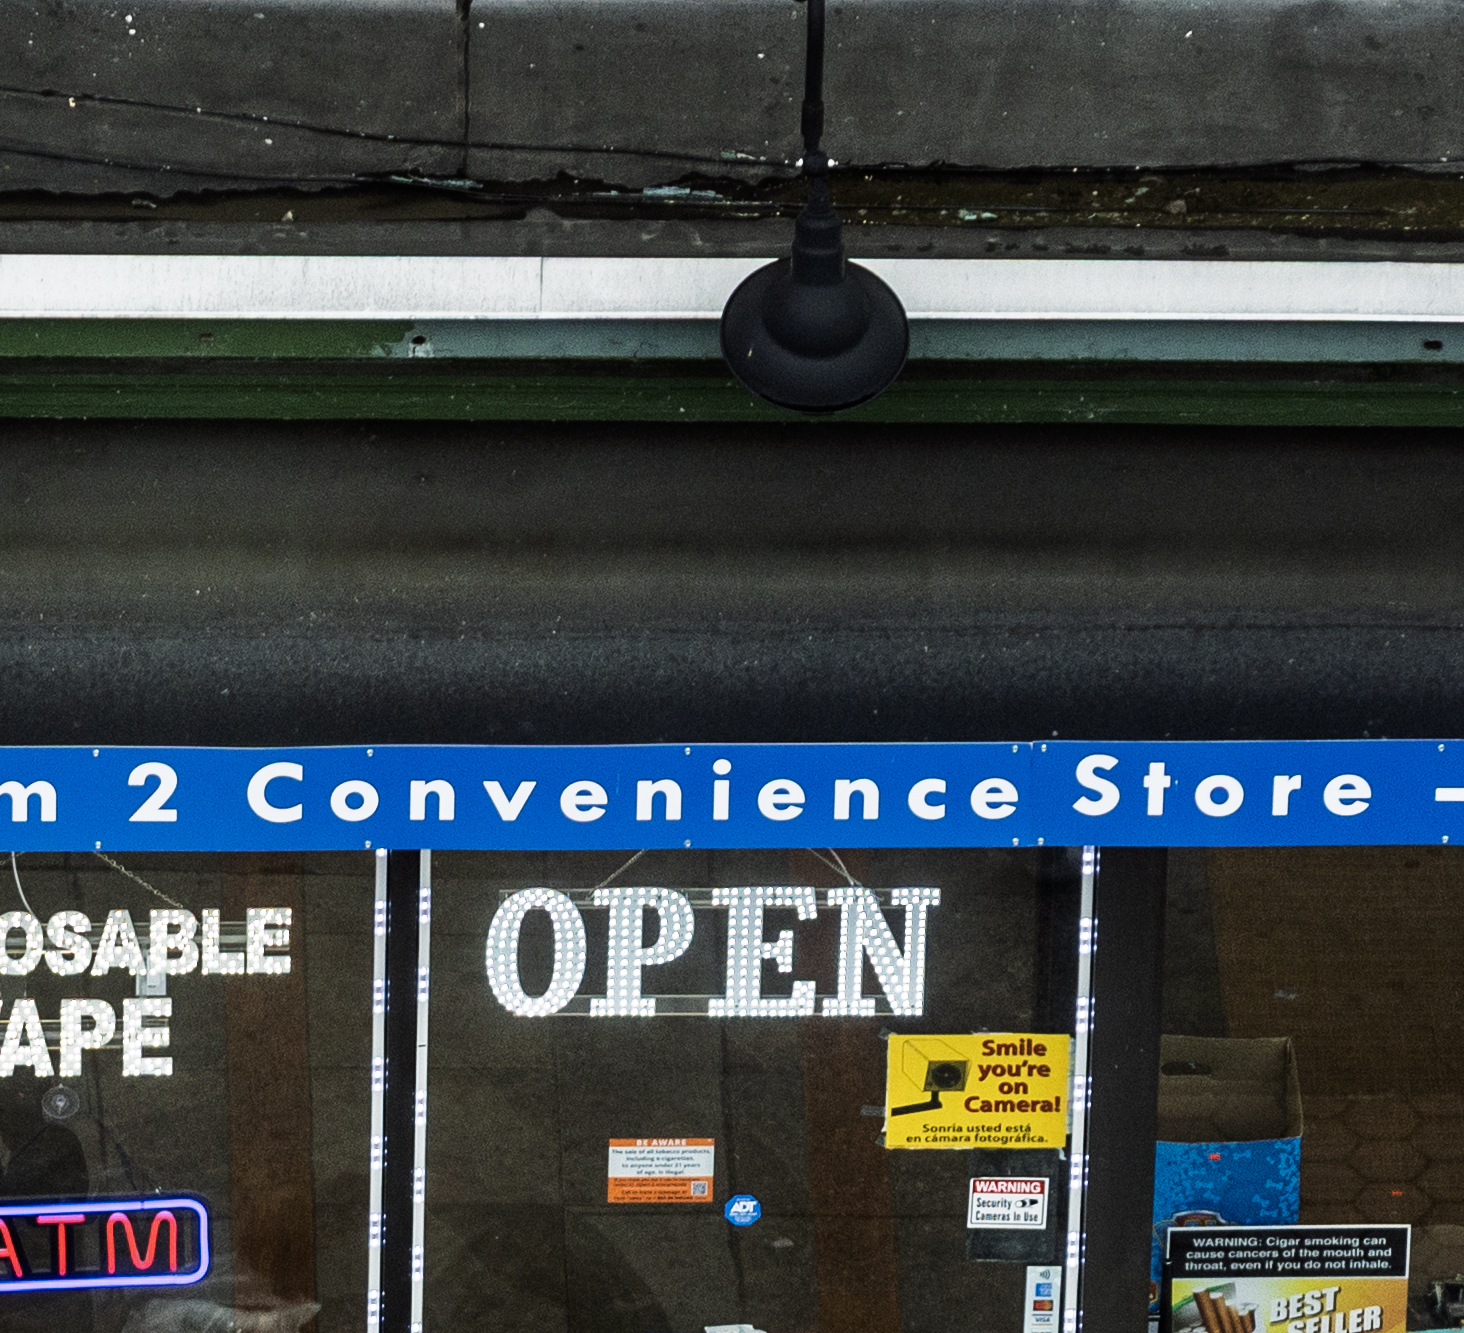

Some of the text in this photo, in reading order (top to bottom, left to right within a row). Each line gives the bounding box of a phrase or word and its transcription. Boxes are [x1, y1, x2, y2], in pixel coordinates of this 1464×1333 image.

[128, 762, 177, 821] 2
[247, 760, 1018, 824] Convenience
[1074, 757, 1374, 820] Store
[485, 885, 941, 1018] OPEN
[982, 1039, 1047, 1056] Smile
[978, 1060, 1051, 1081] you're
[998, 1081, 1028, 1094] on
[964, 1096, 1062, 1113] Camera!
[966, 1122, 1032, 1133] usted está
[906, 1134, 922, 1142] en
[924, 1133, 971, 1143] cámara
[975, 1181, 1041, 1194] WARNING
[730, 1201, 758, 1213] ADT
[976, 1197, 1012, 1209] Security
[975, 1210, 1011, 1222] Cameras
[1023, 1211, 1038, 1222] Use
[1193, 1236, 1387, 1248] WARNING: Cigar smoking can
[1186, 1248, 1392, 1259] cause cancers of the mouth and
[1185, 1259, 1392, 1272] throat, even if you do not inhale.
[1269, 1285, 1340, 1324] BEST
